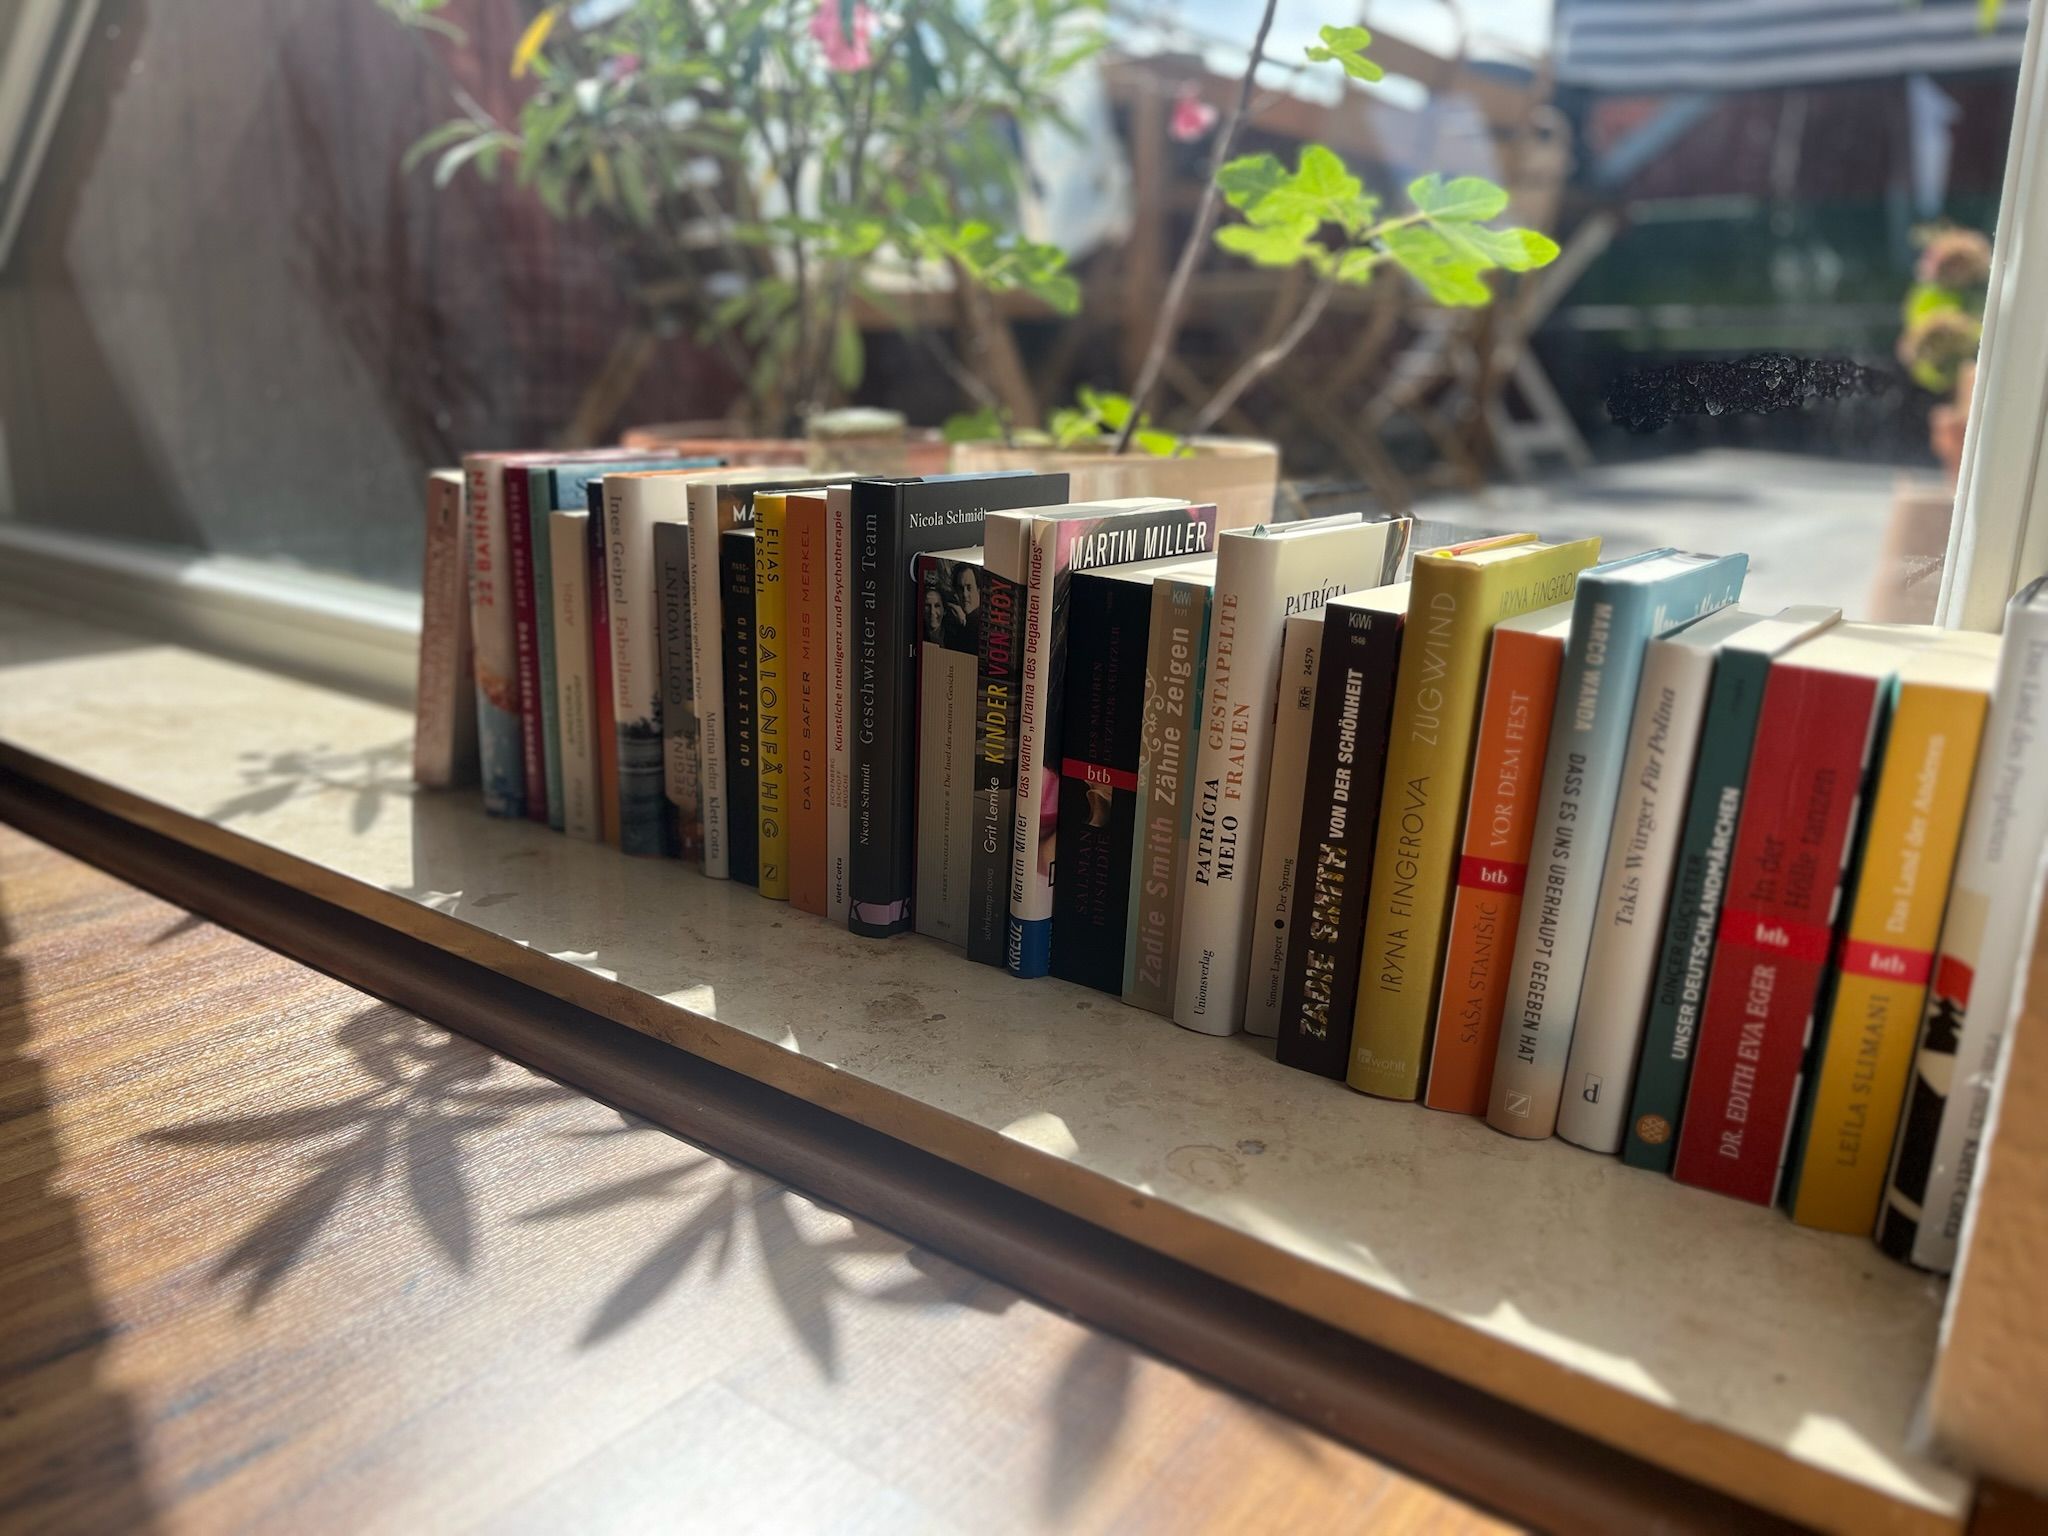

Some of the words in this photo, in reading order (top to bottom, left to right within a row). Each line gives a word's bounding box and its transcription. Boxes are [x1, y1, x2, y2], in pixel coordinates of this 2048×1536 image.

[471, 470, 492, 571] BAHNEN
[609, 495, 624, 537] Ines
[862, 513, 878, 571] Team
[909, 511, 944, 529] Nicola
[611, 540, 630, 606] Geipel
[755, 512, 765, 594] HIRSCHL
[767, 527, 779, 583] ELIAS
[800, 525, 810, 602] MERKEL
[834, 510, 843, 602] Psychotherapie
[1069, 528, 1137, 572] MARTIN
[1142, 521, 1208, 566] MILLER
[477, 579, 494, 607] 22
[664, 561, 681, 644] WOHNT
[834, 603, 843, 627] und
[864, 579, 877, 609] als
[990, 577, 1014, 627] HOY
[1499, 588, 1529, 617] IRYNA
[801, 612, 810, 660] MISS
[1026, 595, 1041, 654] begabten
[1348, 612, 1373, 631] KiWi
[1585, 602, 1614, 666] MARCO
[614, 615, 635, 709] Fabelland
[668, 647, 682, 705] GOTT
[834, 628, 843, 687] Intelligenz
[988, 629, 1010, 676] VON
[1024, 657, 1037, 680] des
[1163, 627, 1192, 718] zeigen
[1208, 593, 1239, 751] GESTAPELTE
[1303, 647, 1315, 676] 24579
[1411, 591, 1457, 746] ZUGWIND
[737, 615, 751, 767] QUALITYLAND
[802, 671, 811, 739] SAFIER
[859, 616, 876, 745] Geschwister
[1573, 669, 1602, 733] WANDA
[705, 711, 717, 756] Martina
[759, 623, 783, 839] SALONFÄHIG
[835, 688, 843, 752] Künstliche
[984, 683, 1009, 765] KINDER
[1338, 668, 1364, 764] SCHÖNHEIT
[1506, 689, 1530, 742] FEST
[1647, 686, 1677, 756] Polina
[673, 727, 686, 796] REGINA
[1020, 734, 1033, 773] wahre
[1087, 764, 1112, 785] btb
[1154, 726, 1182, 806] Zähne
[1224, 703, 1251, 801] FRAUEN
[1497, 748, 1522, 799] DEM
[1563, 752, 1587, 798] DASS
[1640, 752, 1665, 794] Für
[803, 749, 811, 811] DAVID
[860, 763, 871, 807] Schmidt
[984, 776, 1000, 823] Lemke
[1017, 777, 1030, 799] Das
[1333, 767, 1352, 802] DER
[709, 795, 721, 860] Klett-Cotta
[859, 806, 871, 846] Nicola
[1015, 814, 1029, 854] Miller
[1194, 777, 1220, 886] PATRÍCIA
[1329, 801, 1348, 839] VON
[1490, 804, 1512, 847] VOR
[1558, 799, 1579, 823] ES
[1625, 795, 1658, 871] Würger
[983, 825, 998, 854] Grit
[1145, 815, 1175, 898] Smith
[1216, 815, 1240, 881] MELO
[1390, 775, 1431, 918] FINGEROVA
[1552, 826, 1574, 861] UNS
[986, 867, 995, 893] nova
[1011, 855, 1025, 904] Martin
[1075, 830, 1091, 914] SALMAN
[1091, 832, 1110, 927] RUSHDIE
[1278, 857, 1294, 892] Sprung
[1480, 866, 1508, 886] btb
[1682, 786, 1741, 1002] DEUTSCHLANDMÄRCHEN
[982, 894, 995, 942] suhrkamp
[1275, 892, 1287, 913] Der
[1615, 876, 1642, 928] Takis
[1008, 922, 1024, 972] KREUZ
[1139, 908, 1168, 988] Zadie
[1271, 935, 1288, 974] Lappert
[1380, 928, 1409, 993] IRYNA
[1755, 922, 1789, 948] btb
[1193, 948, 1216, 1016] Unionsverlag
[1265, 971, 1280, 1008] Simone
[1870, 951, 1906, 975] btb
[1300, 950, 1337, 1041] ZADIE
[1522, 959, 1551, 1034] GEGEBEN
[1745, 963, 1778, 1019] EGER
[1460, 997, 1484, 1046] SAŠA
[1671, 1004, 1698, 1061] UNSER
[1737, 1019, 1767, 1062] EVA
[1853, 993, 1892, 1096] SLIMANI
[1517, 1034, 1539, 1065] HAT
[1726, 1061, 1757, 1123] EDITH
[1719, 1124, 1744, 1161] DR.
